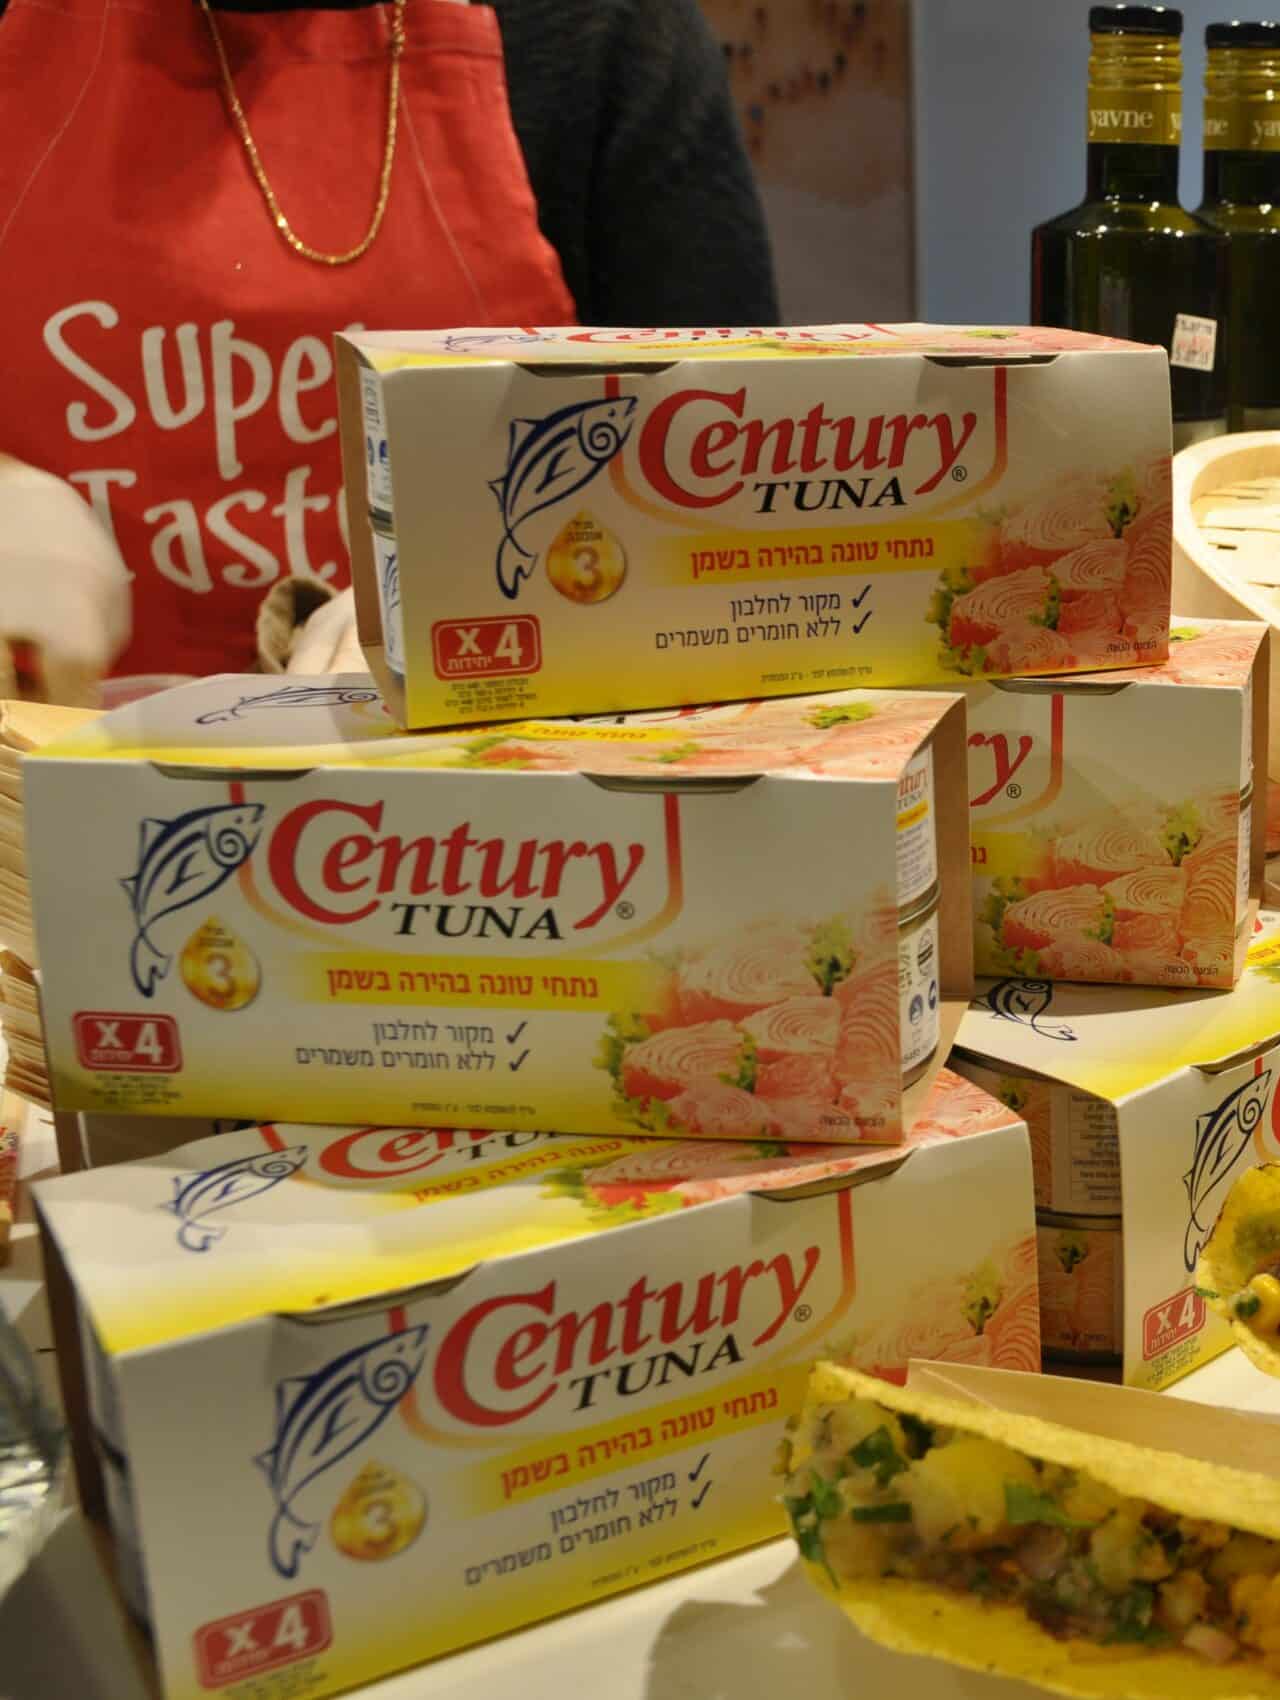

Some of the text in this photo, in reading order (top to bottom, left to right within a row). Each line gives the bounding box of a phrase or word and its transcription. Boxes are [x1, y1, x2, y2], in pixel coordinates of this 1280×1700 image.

[639, 385, 977, 509] Century
[753, 477, 906, 513] TUNA
[70, 466, 352, 592] Tast
[574, 547, 604, 591] 3
[691, 536, 934, 578] נתחי טונה בהירה בשמן
[730, 591, 841, 622] מקור לחלבון
[495, 624, 523, 665] 4
[655, 617, 841, 649] ללא חומרים משמרים
[267, 799, 646, 930] Century
[389, 903, 564, 940] TUNA
[327, 967, 599, 998] נתחי טונה בהירה בשמן
[135, 1022, 164, 1064] 4
[372, 1018, 494, 1049] מקור לחלבון
[295, 1046, 496, 1072] ללא חומרים משמרים
[1178, 1293, 1196, 1328] 4
[433, 1246, 821, 1428] Century
[569, 1333, 744, 1412] TUNA
[501, 1388, 778, 1499] נתחי טונה בהירה בשמן
[549, 1473, 676, 1531] מקור לחלבון
[638, 1498, 678, 1528] ללא
[559, 1514, 632, 1554] חומרים
[463, 1543, 553, 1587] משמרים
[274, 1603, 310, 1649] 4
